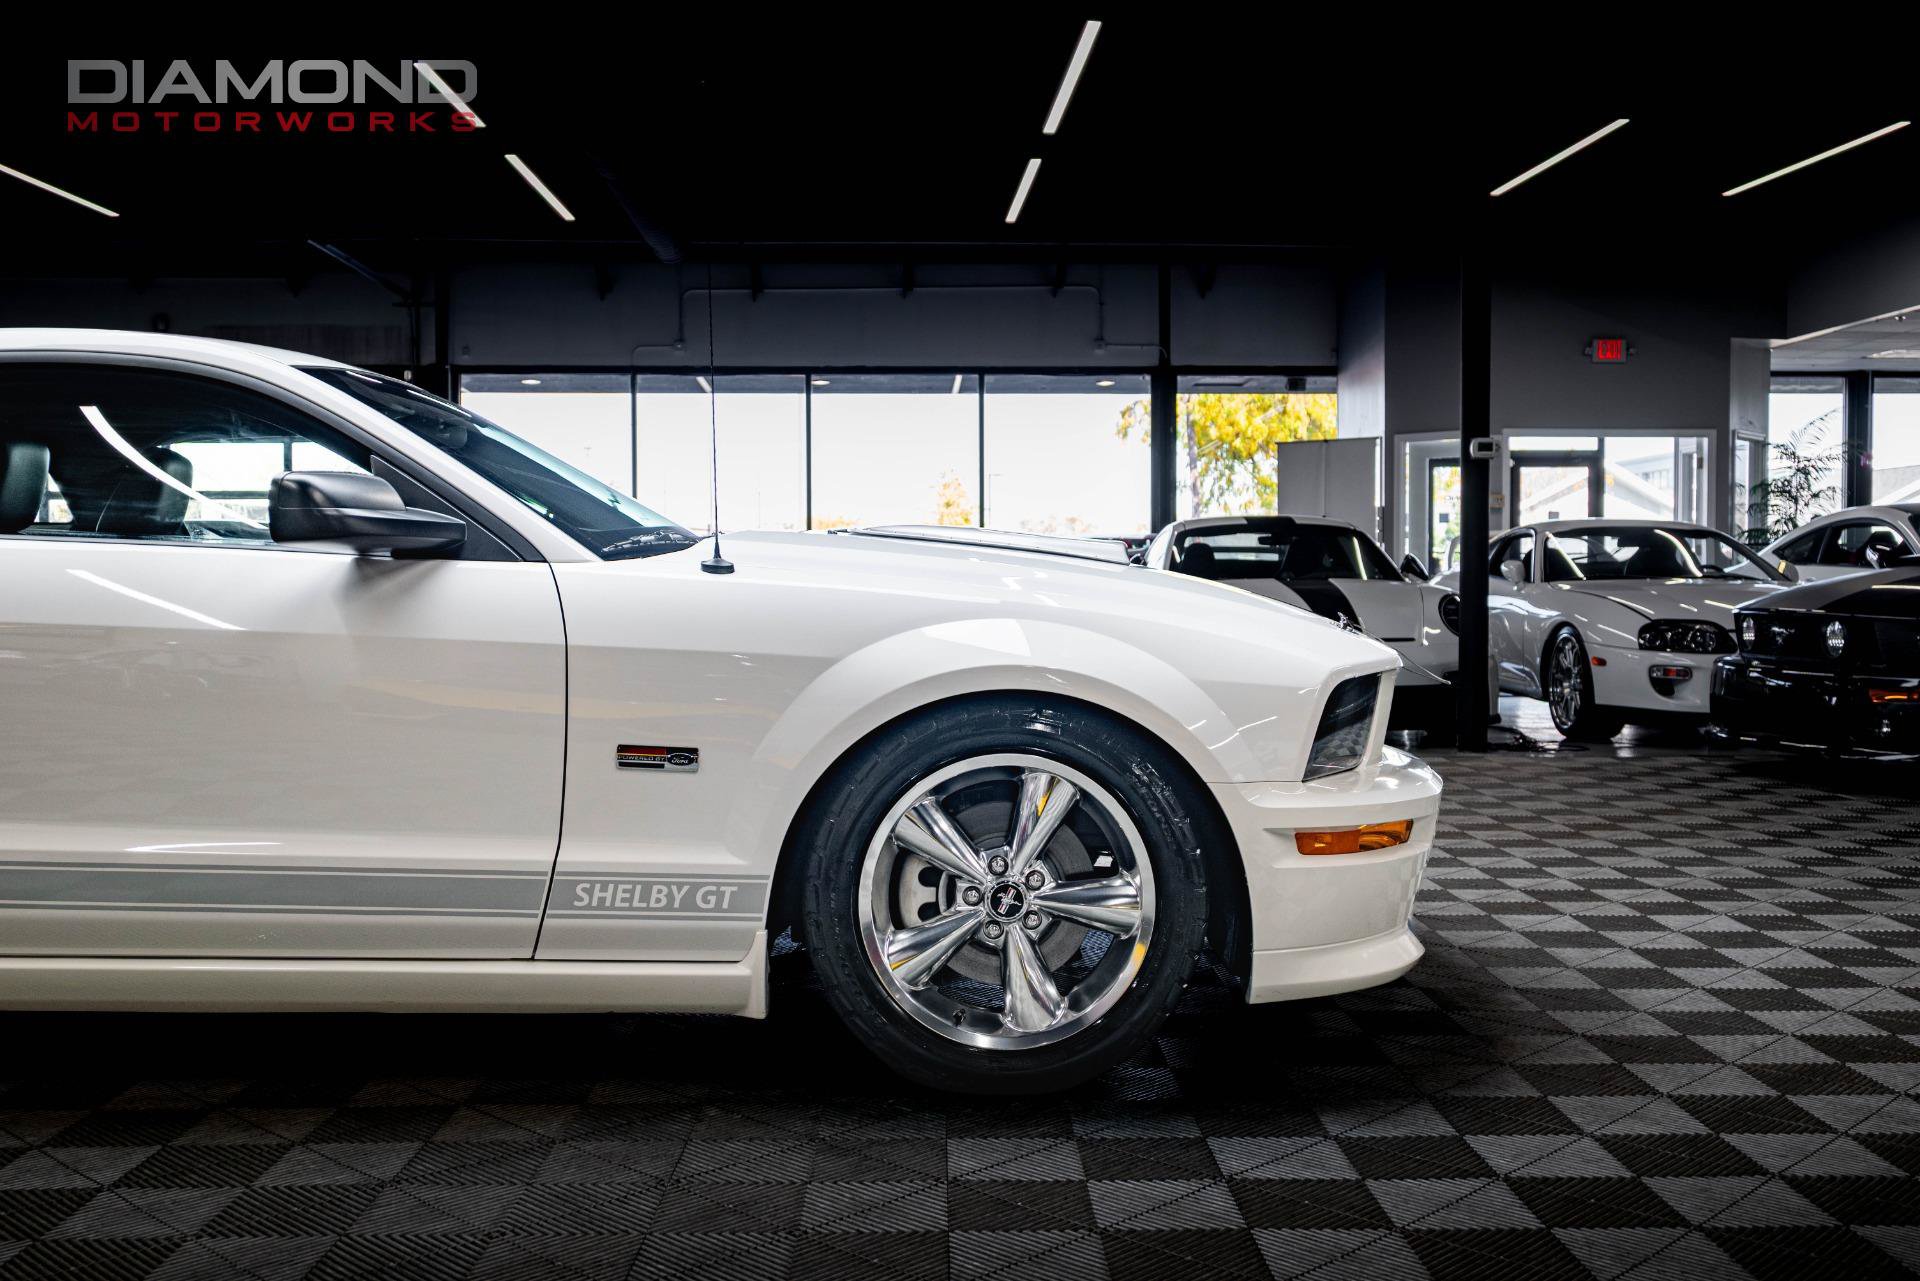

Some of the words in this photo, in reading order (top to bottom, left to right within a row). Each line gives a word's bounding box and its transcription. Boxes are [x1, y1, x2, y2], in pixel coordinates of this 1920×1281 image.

[671, 756, 689, 764] Ford
[573, 882, 690, 908] SHELBY
[695, 885, 738, 909] GT
